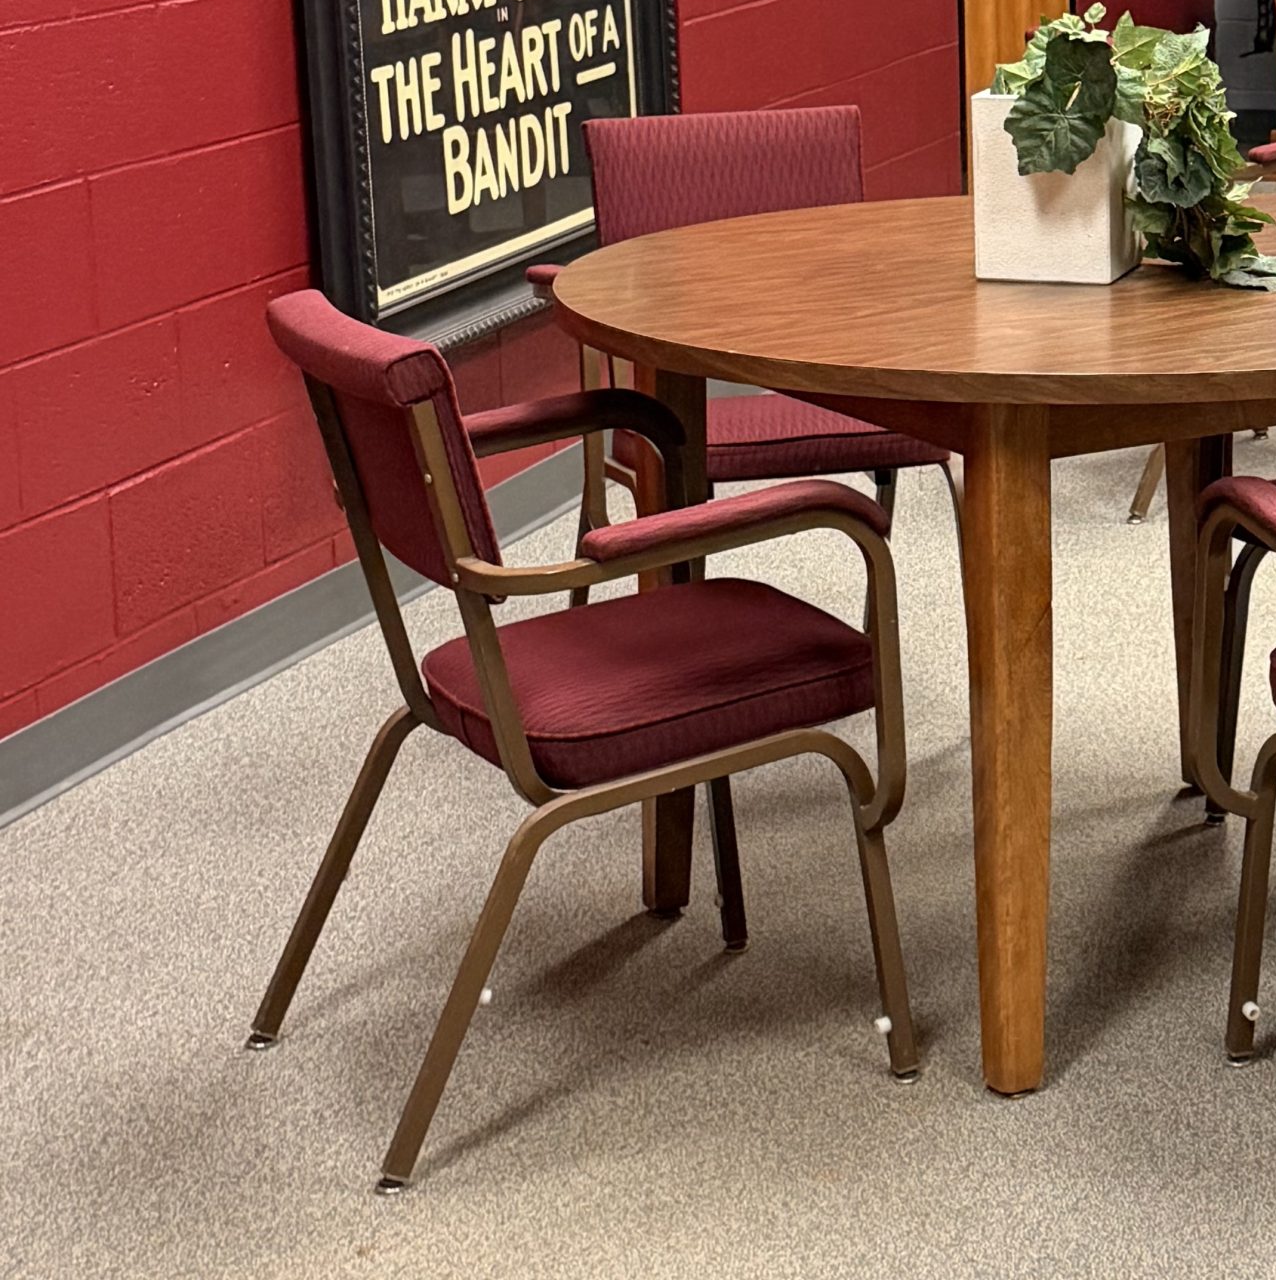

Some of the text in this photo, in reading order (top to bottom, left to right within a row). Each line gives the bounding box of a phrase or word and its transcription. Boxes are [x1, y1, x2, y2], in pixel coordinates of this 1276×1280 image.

[496, 7, 509, 22] IN
[370, 4, 621, 144] THE HEART OF A
[442, 102, 573, 215] BANDIT
